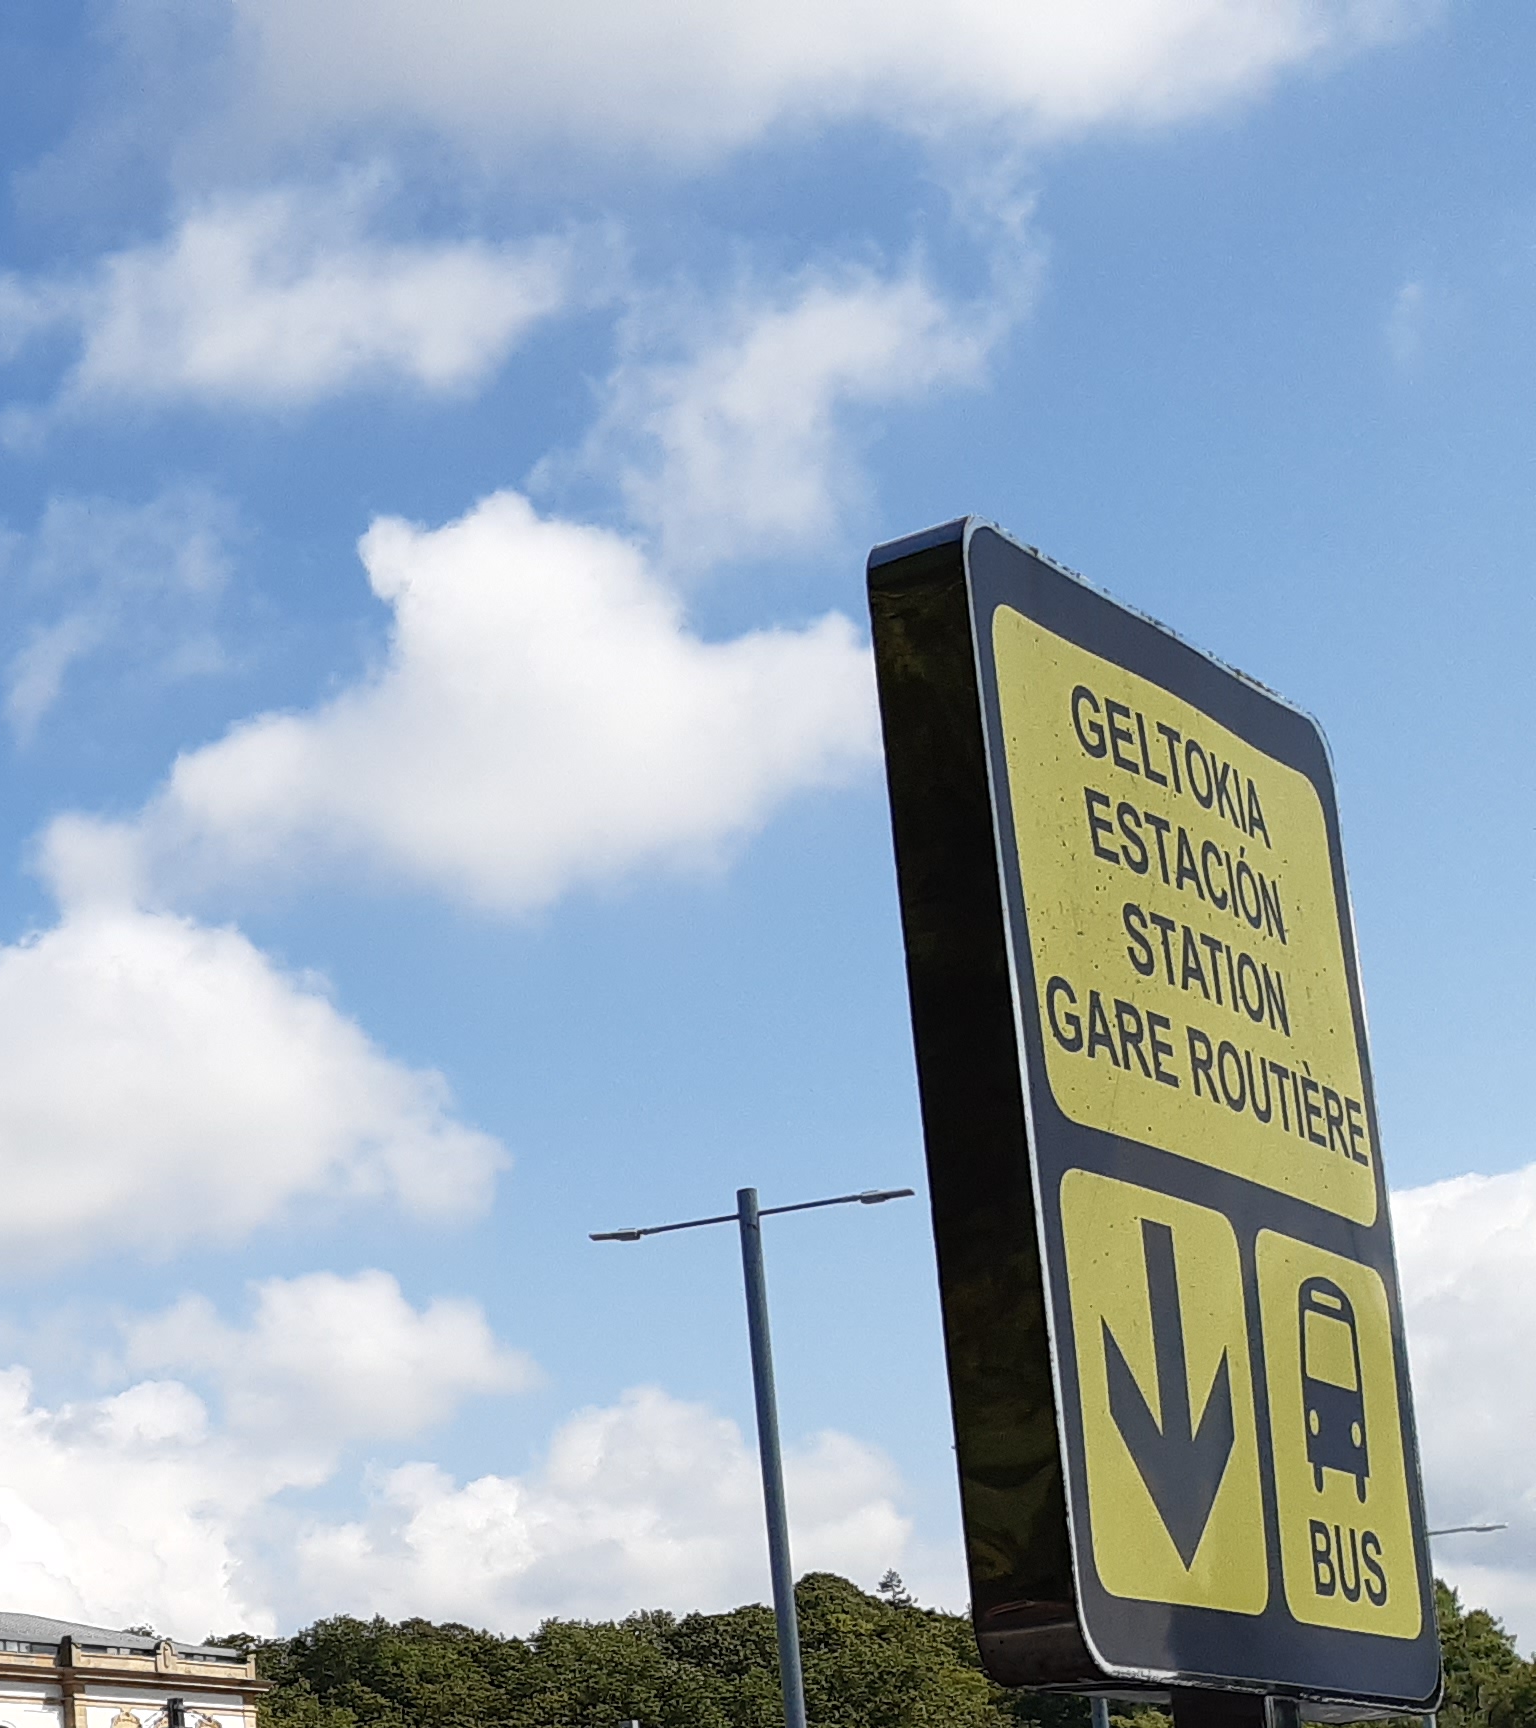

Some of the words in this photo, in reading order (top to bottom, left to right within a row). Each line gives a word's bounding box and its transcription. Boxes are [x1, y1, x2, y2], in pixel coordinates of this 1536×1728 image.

[1070, 684, 1273, 850] GELTOKIA
[1084, 786, 1287, 946] ESTACIÓN
[1122, 902, 1291, 1038] STATION
[1045, 974, 1180, 1090] GARE
[1186, 1024, 1370, 1169] ROUTIÈRE
[1308, 1518, 1388, 1608] BUS
